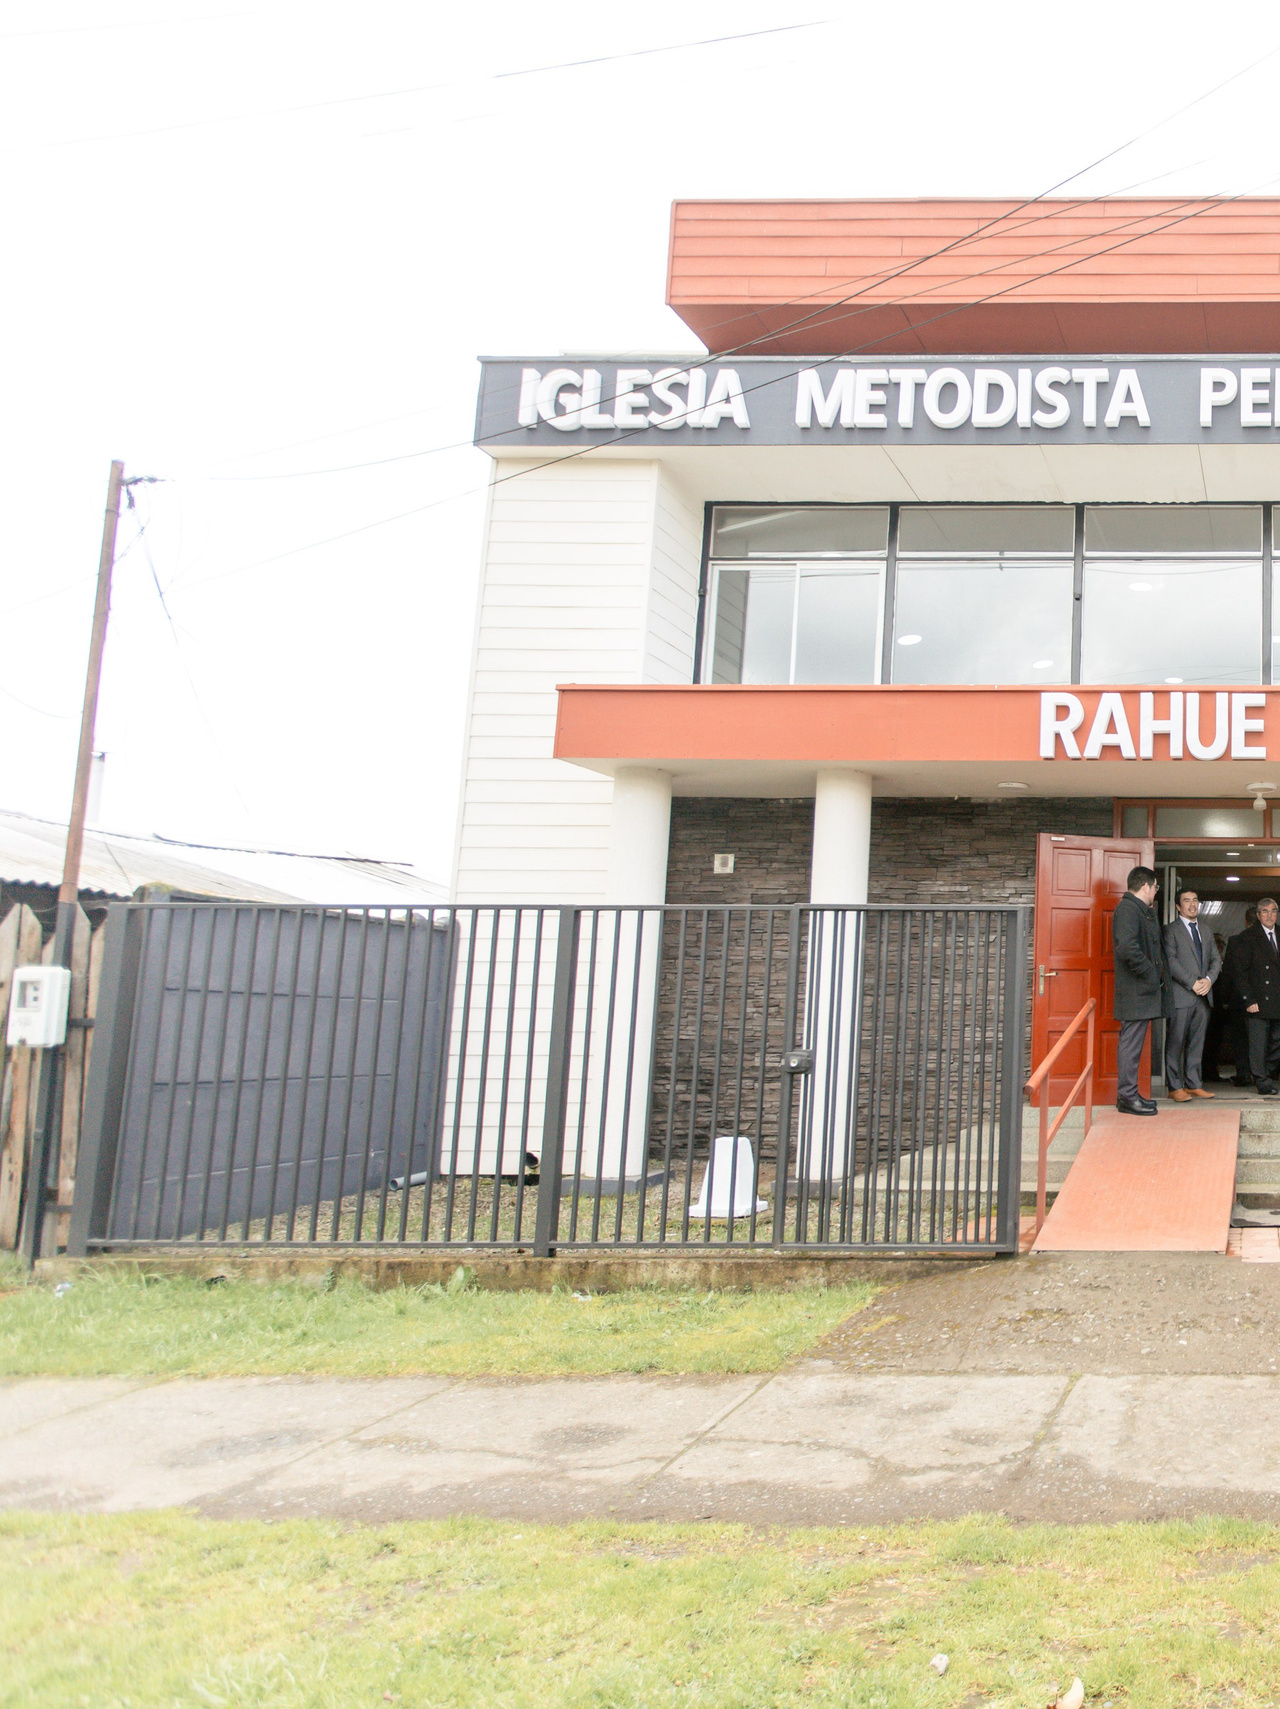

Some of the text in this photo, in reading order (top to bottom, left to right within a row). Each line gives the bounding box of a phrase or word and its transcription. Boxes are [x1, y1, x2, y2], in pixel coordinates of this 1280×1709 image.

[517, 367, 751, 432] IGLESIA
[795, 367, 1150, 429] METODISTA
[1039, 691, 1267, 761] RAHUE
